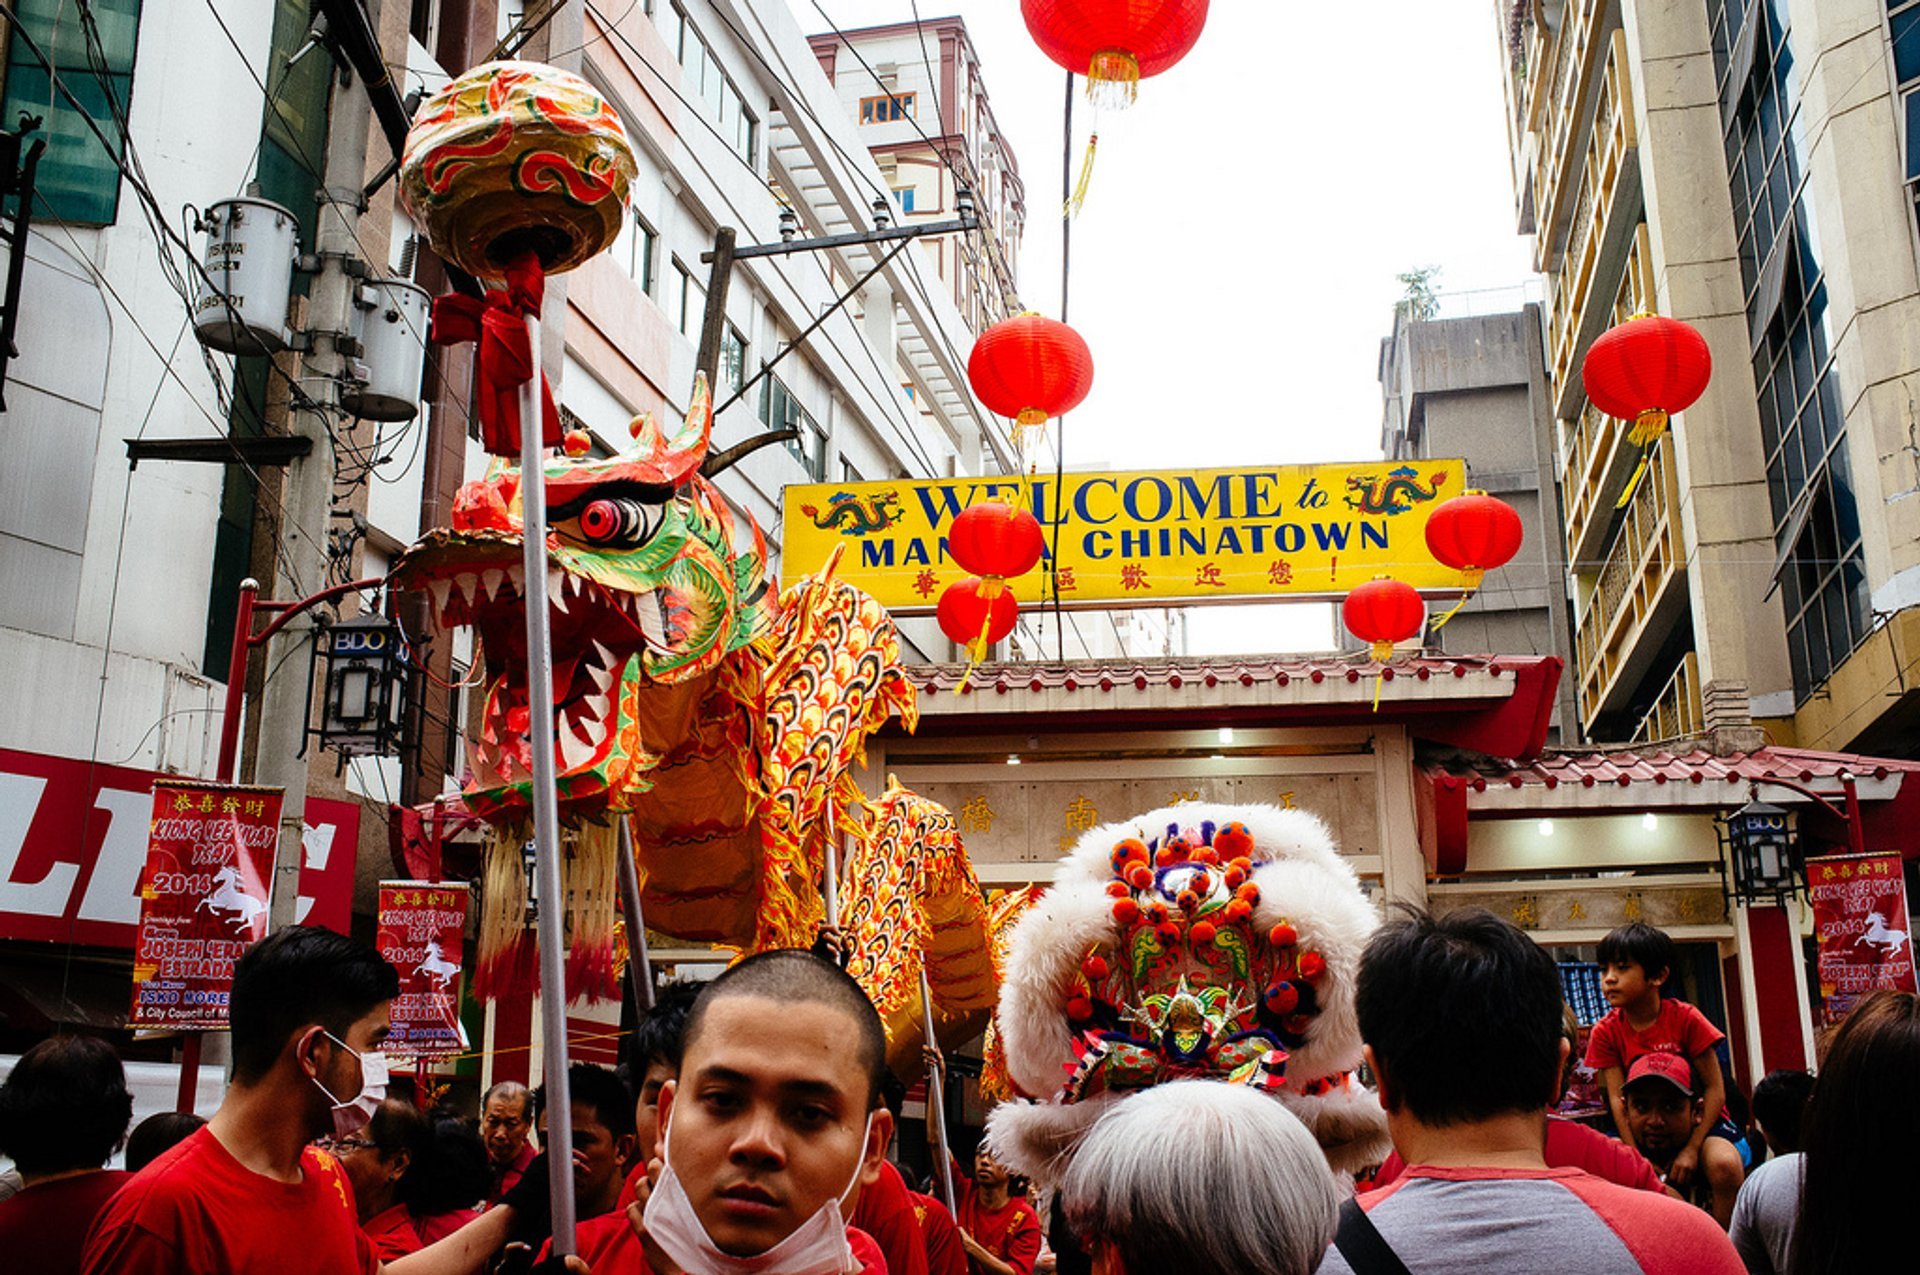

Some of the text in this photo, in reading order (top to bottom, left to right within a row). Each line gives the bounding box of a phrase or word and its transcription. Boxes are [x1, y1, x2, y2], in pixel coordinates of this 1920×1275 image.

[1294, 478, 1328, 509] to
[1082, 520, 1389, 560] CHINATOWN
[335, 631, 386, 650] BDO
[173, 793, 265, 817] 恭喜發財
[1746, 815, 1784, 830] BDO
[152, 872, 211, 895] 2014
[1822, 919, 1865, 938] 2014
[140, 939, 205, 960] JOSEPH
[382, 946, 424, 963] 2014
[160, 958, 234, 979] ESTRADA
[139, 990, 179, 1005] ISKO
[146, 1007, 166, 1021] City
[168, 1007, 203, 1019] Council
[204, 1008, 217, 1018] of
